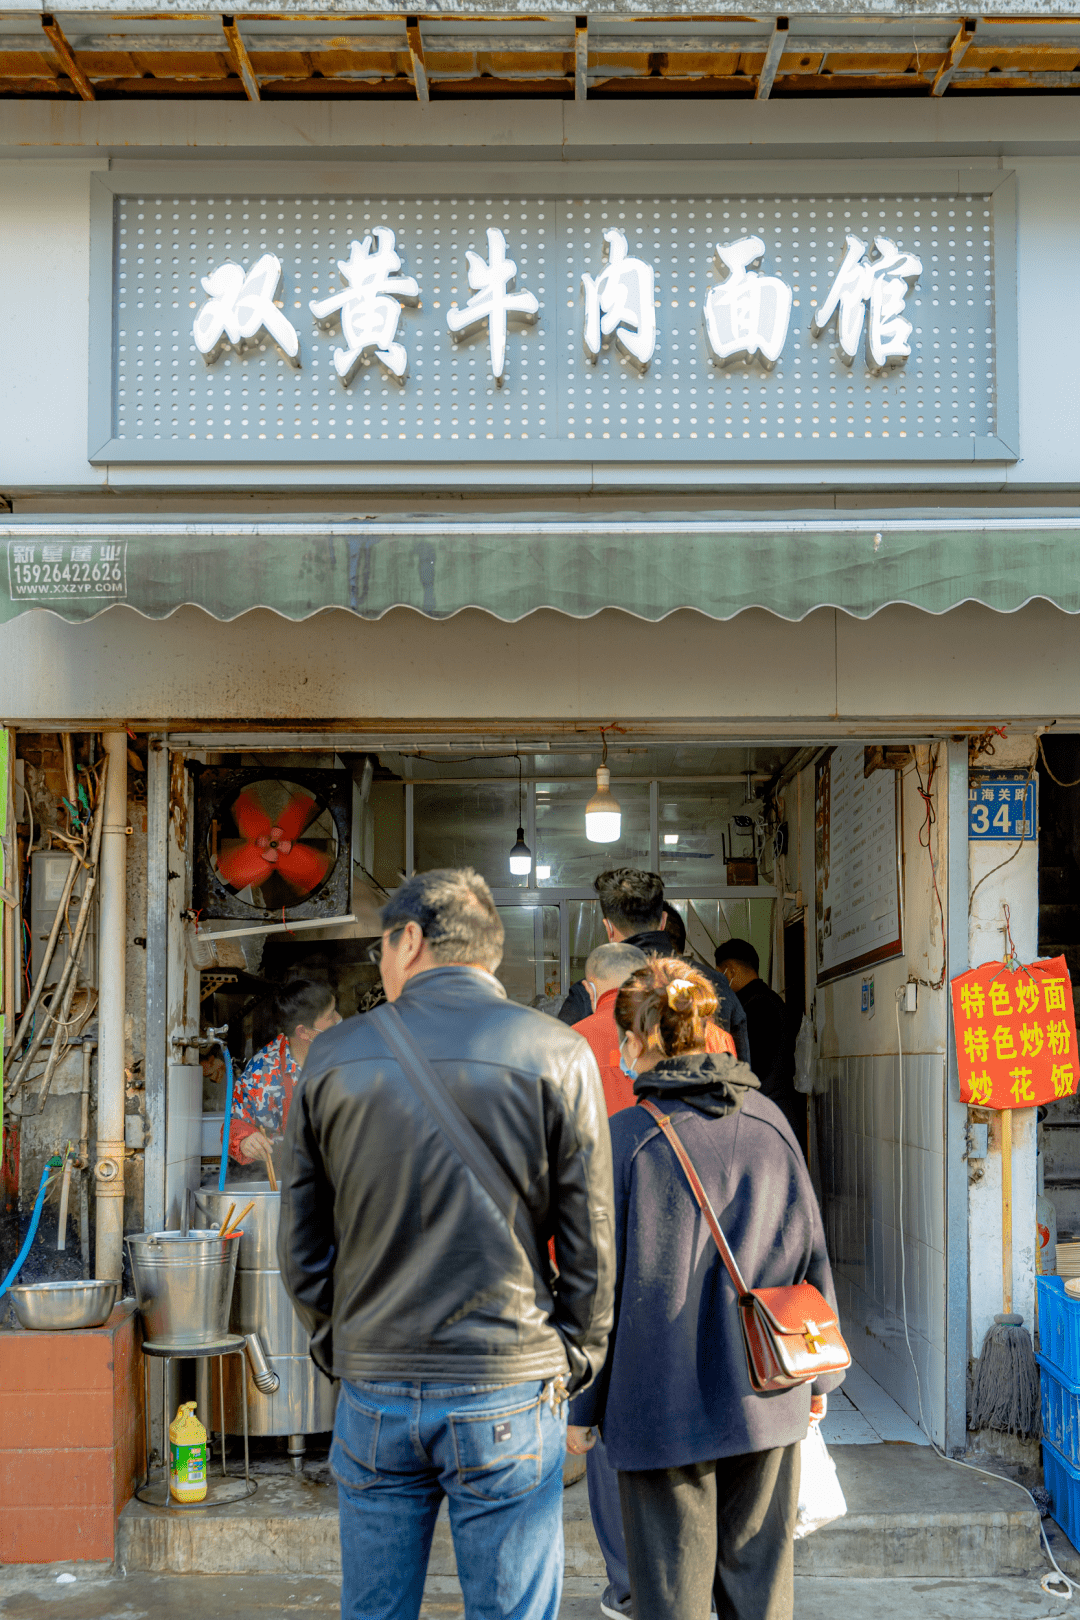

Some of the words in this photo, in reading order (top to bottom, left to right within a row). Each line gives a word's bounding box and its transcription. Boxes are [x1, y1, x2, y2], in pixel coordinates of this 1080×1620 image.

[192, 226, 923, 381] 双黄牛肉面馆
[14, 562, 121, 583] 15926422626
[16, 583, 122, 594] WWW.XXZYP.COM
[968, 788, 1028, 801] 山海关路
[971, 804, 1012, 833] 34
[960, 977, 1066, 1019] 特色炒面
[963, 1019, 1071, 1063] 特色炒粉
[967, 1062, 1074, 1105] 炒花饭
